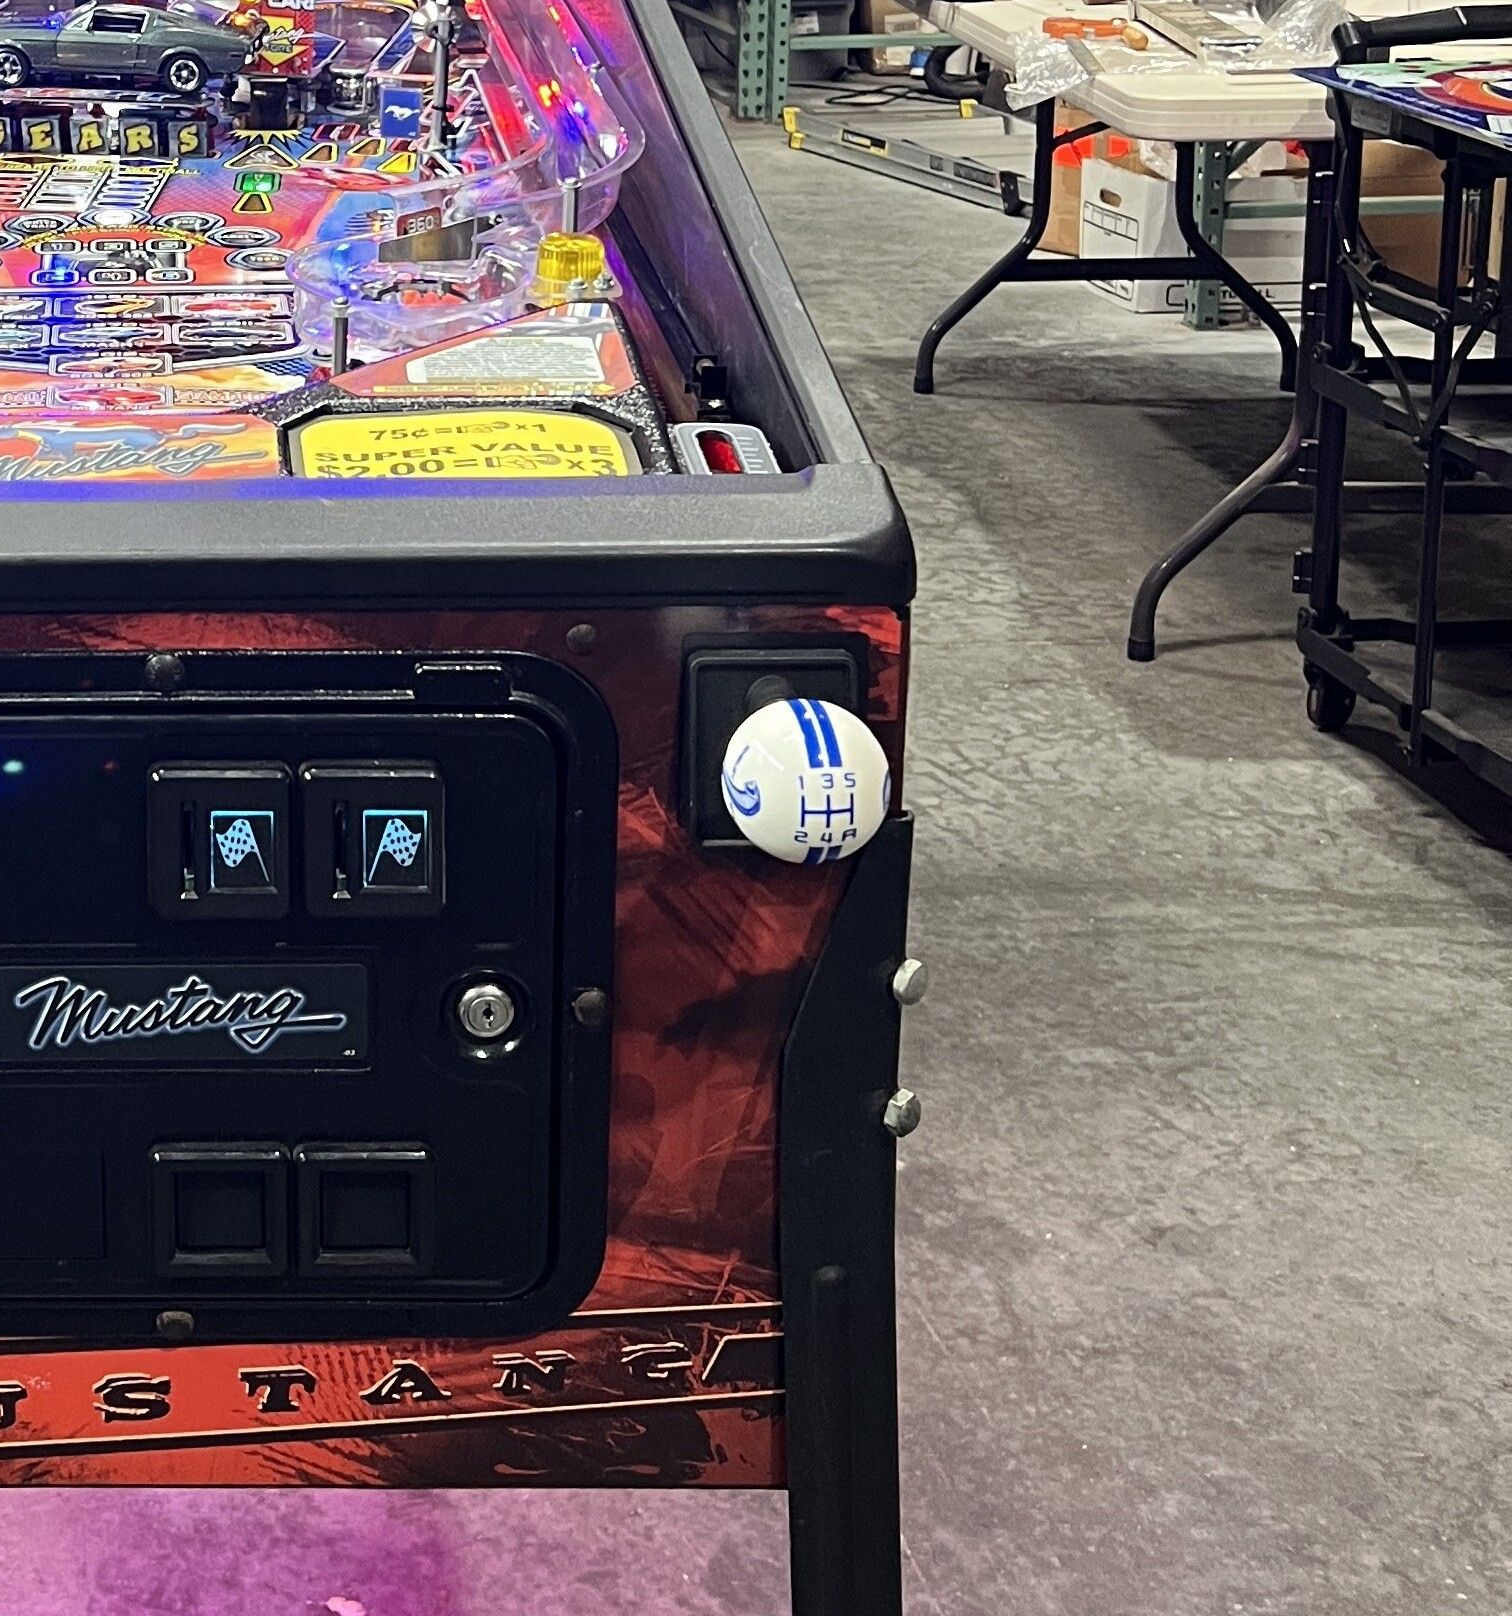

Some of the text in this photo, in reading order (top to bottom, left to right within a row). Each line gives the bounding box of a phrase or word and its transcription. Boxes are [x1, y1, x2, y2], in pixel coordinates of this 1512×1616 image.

[315, 441, 613, 463] SUPER VALUE
[798, 775, 805, 790] 1
[821, 773, 834, 789] 3
[795, 830, 808, 843] 2
[821, 831, 833, 843] 4
[15, 975, 346, 1052] Mustang
